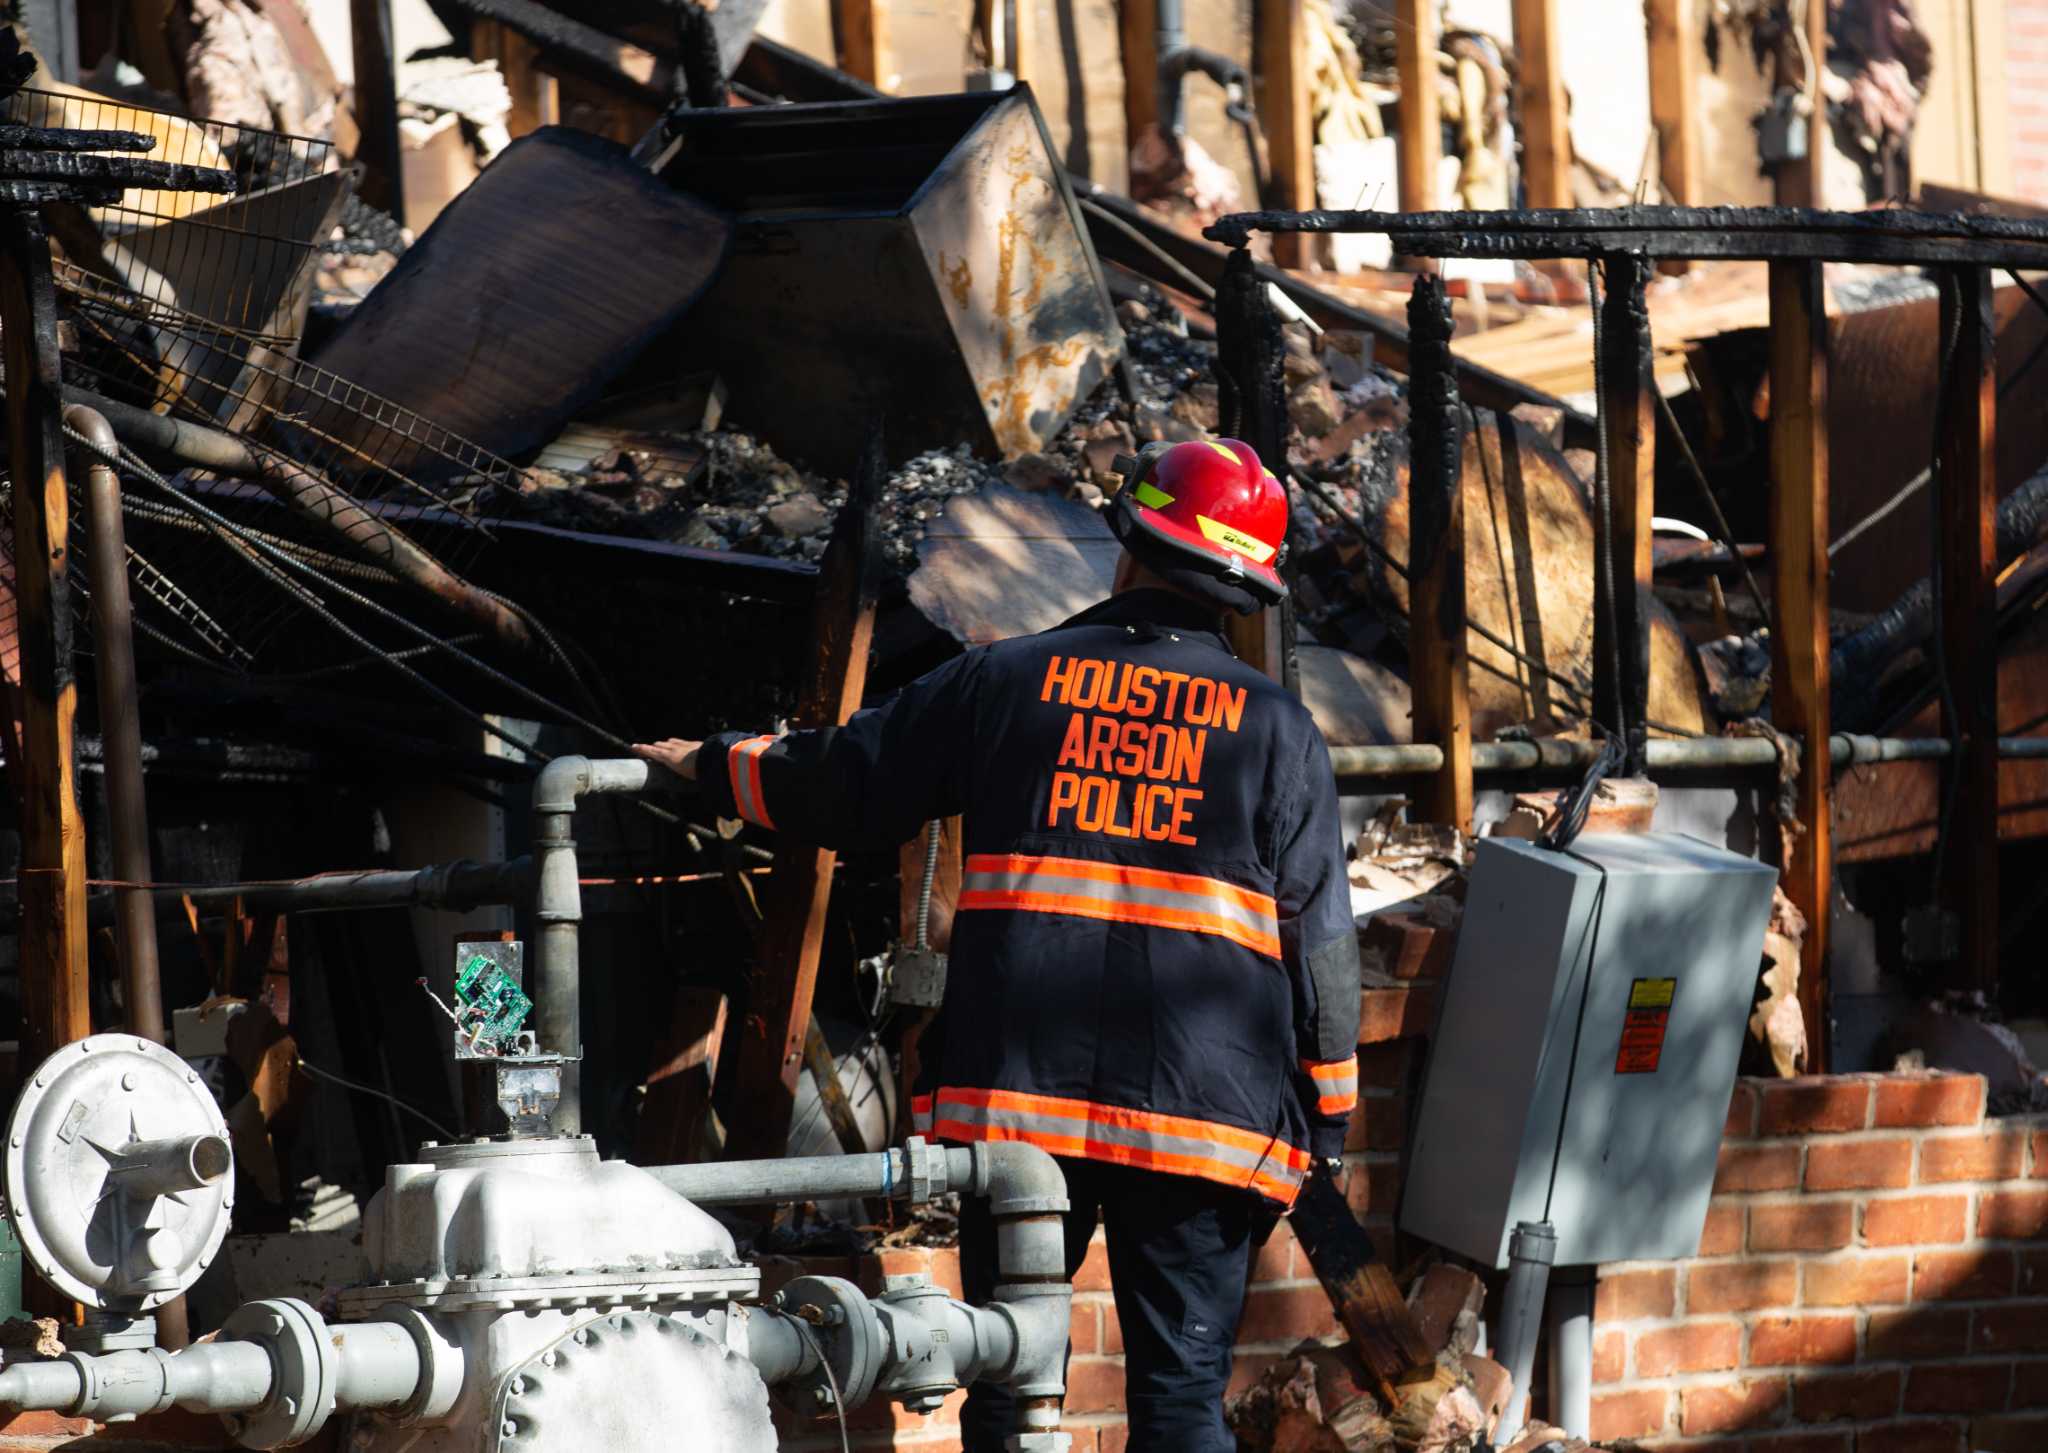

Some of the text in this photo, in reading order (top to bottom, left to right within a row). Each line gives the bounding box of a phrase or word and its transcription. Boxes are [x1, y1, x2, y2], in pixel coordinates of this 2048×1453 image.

[1041, 656, 1247, 732] HOUSTON
[1057, 713, 1207, 783] ARSON
[1048, 772, 1203, 845] POLICE
